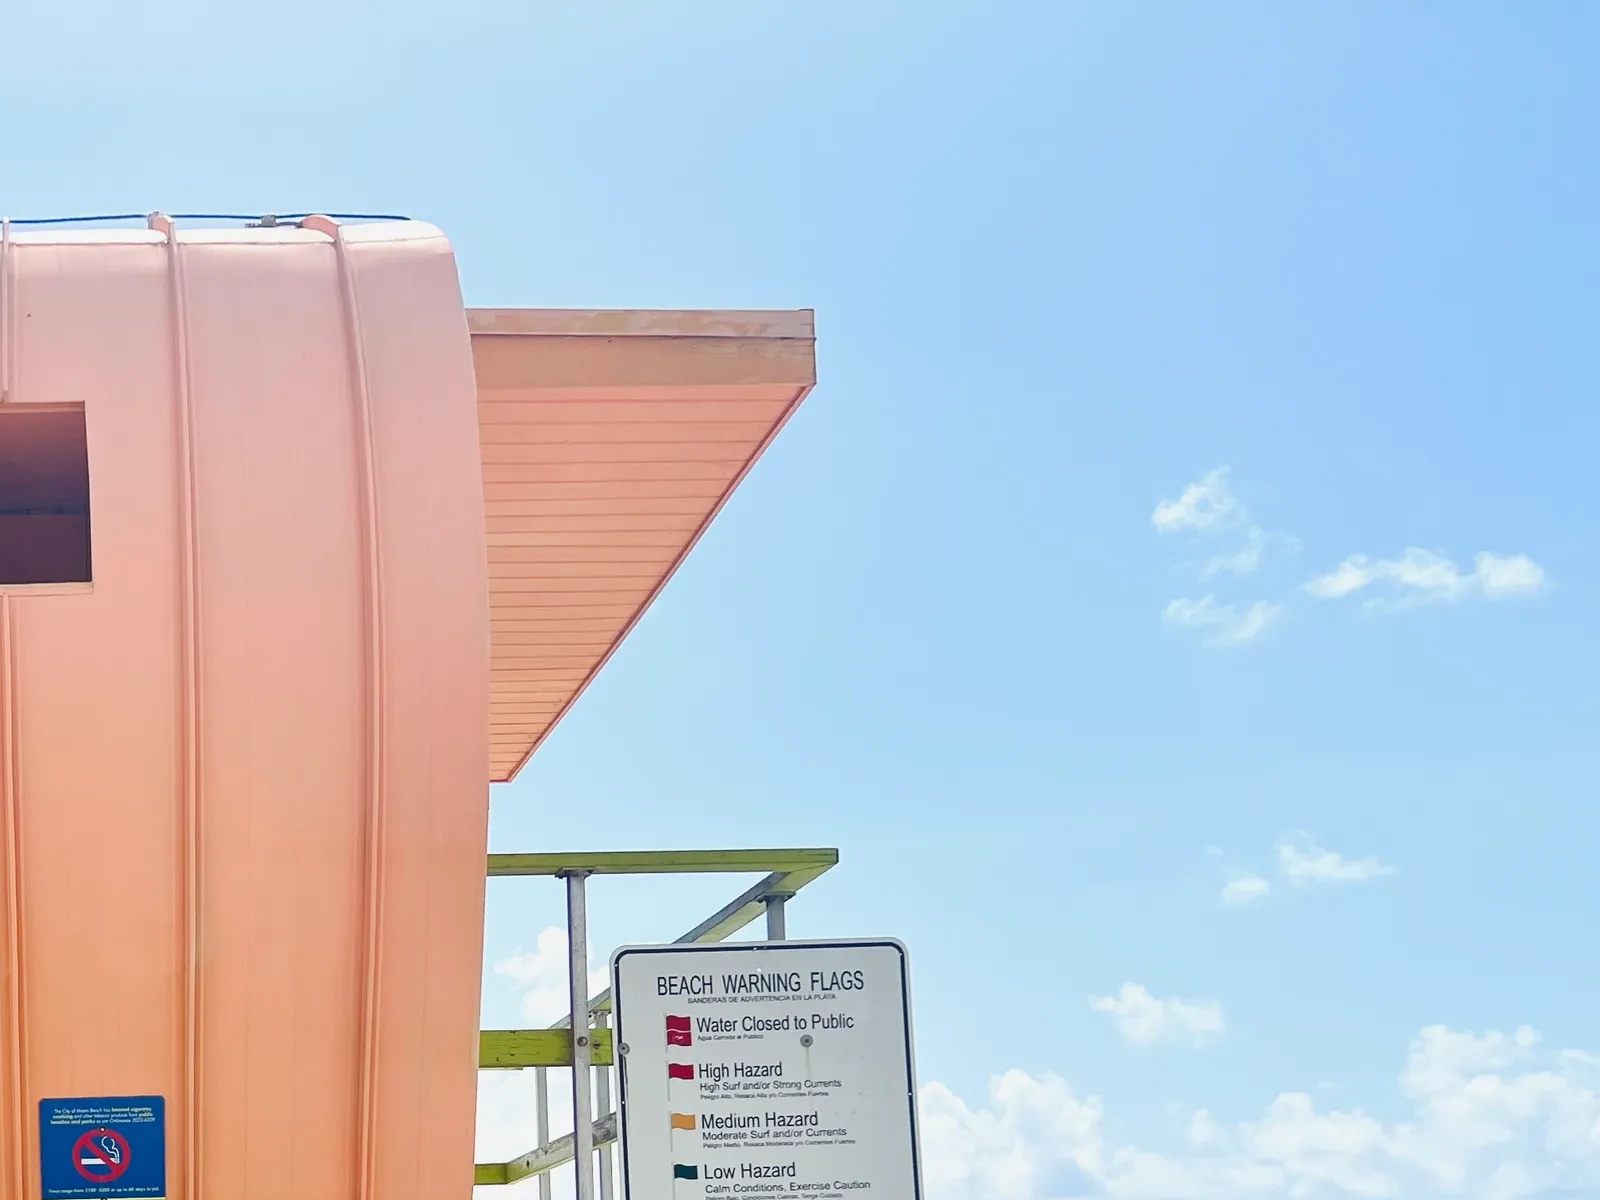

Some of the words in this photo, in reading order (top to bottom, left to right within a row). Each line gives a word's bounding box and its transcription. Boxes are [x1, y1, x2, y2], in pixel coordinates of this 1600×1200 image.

[657, 975, 713, 996] BEACH
[722, 972, 801, 995] WARNING
[810, 970, 865, 991] FLAGS
[696, 1017, 738, 1033] Water
[742, 1015, 789, 1031] Closed
[794, 1016, 807, 1030] to
[811, 1013, 854, 1029] Public
[699, 1063, 729, 1082] High
[734, 1062, 783, 1078] Hazard
[700, 1083, 720, 1093] High
[722, 1082, 741, 1091] Surf
[743, 1081, 771, 1090] and/or
[772, 1080, 802, 1090] Strong
[804, 1079, 842, 1088] Currents
[701, 1112, 760, 1129] Medium
[765, 1111, 818, 1127] Hazard
[702, 1131, 748, 1141] Moderate
[750, 1130, 770, 1139] Surf
[772, 1129, 803, 1138] and/or
[805, 1128, 847, 1137] Currents
[704, 1164, 736, 1180] Low
[741, 1162, 796, 1178] Hazard
[705, 1185, 731, 1194] Calm
[733, 1183, 786, 1193] Conditions,
[789, 1182, 831, 1191] Exercise
[833, 1180, 871, 1189] Caution
